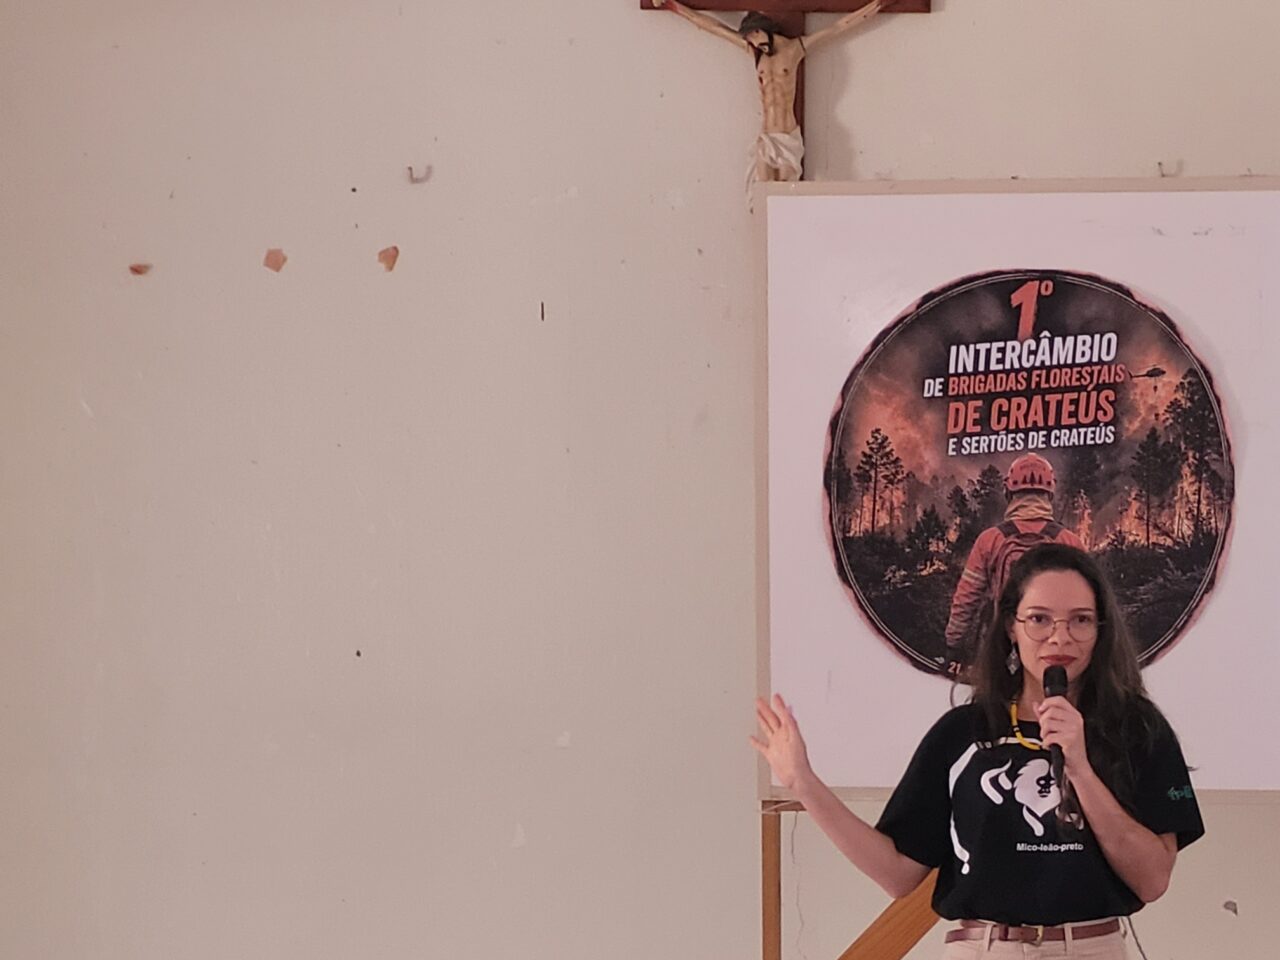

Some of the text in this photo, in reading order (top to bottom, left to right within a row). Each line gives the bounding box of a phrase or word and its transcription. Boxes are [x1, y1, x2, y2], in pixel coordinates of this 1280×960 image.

[948, 330, 1118, 374] INTERCÂMBIO
[923, 364, 1126, 398] DE BRIGADAS FLORESTAIS
[946, 382, 1116, 434] DE CRATEÚS
[948, 423, 1116, 456] E SERTÕES DE CRATEÚS
